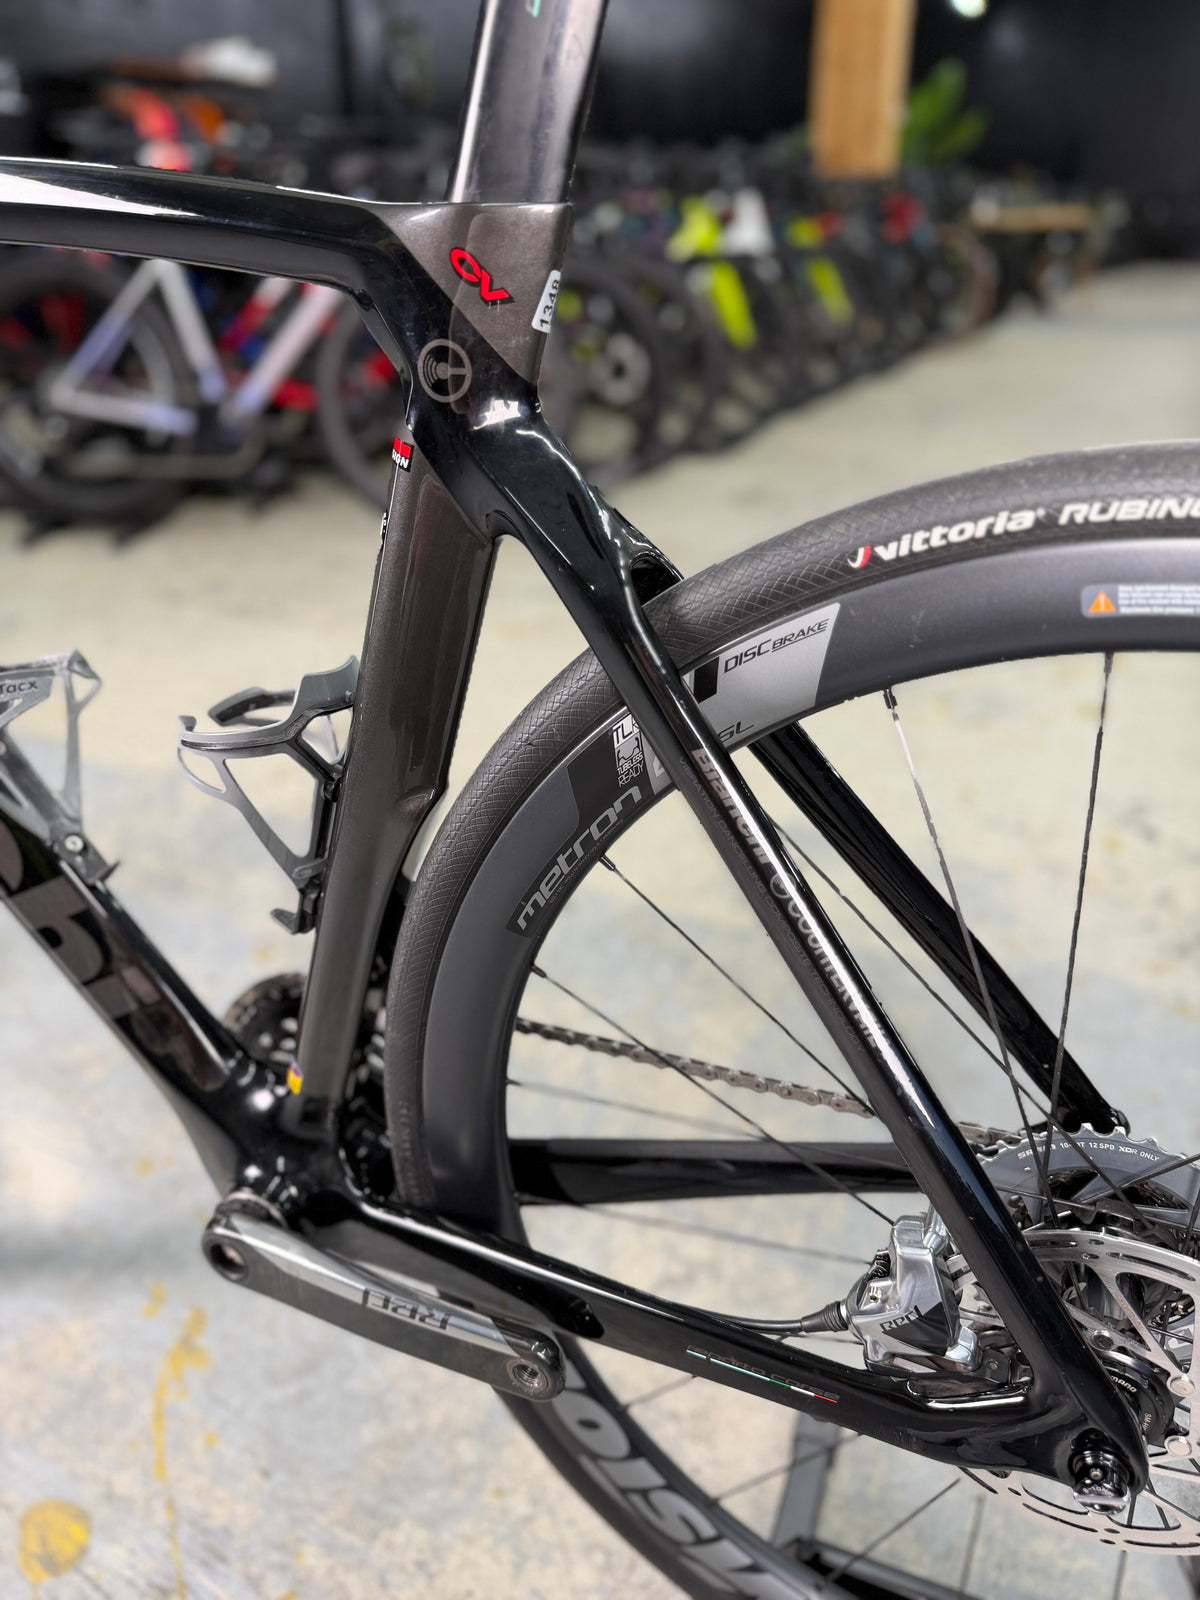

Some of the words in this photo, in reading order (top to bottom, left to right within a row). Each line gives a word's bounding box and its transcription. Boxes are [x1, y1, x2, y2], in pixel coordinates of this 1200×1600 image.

[540, 279, 560, 327] 1348
[874, 508, 1038, 561] vittoria
[724, 639, 771, 673] DISC
[771, 619, 829, 651] BRAKE
[617, 751, 643, 775] TUBELESS
[618, 760, 644, 788] READY
[517, 785, 642, 930] metron
[679, 755, 720, 818] VIBRATION
[718, 820, 769, 895] CANCELLING
[765, 896, 811, 968] COMPOSITE
[811, 967, 864, 1051] TECHNOLOGY
[1060, 1141, 1085, 1149] 10-T
[1118, 1146, 1138, 1155] XDR
[1139, 1151, 1160, 1162] ONLY
[769, 1372, 841, 1400] corse
